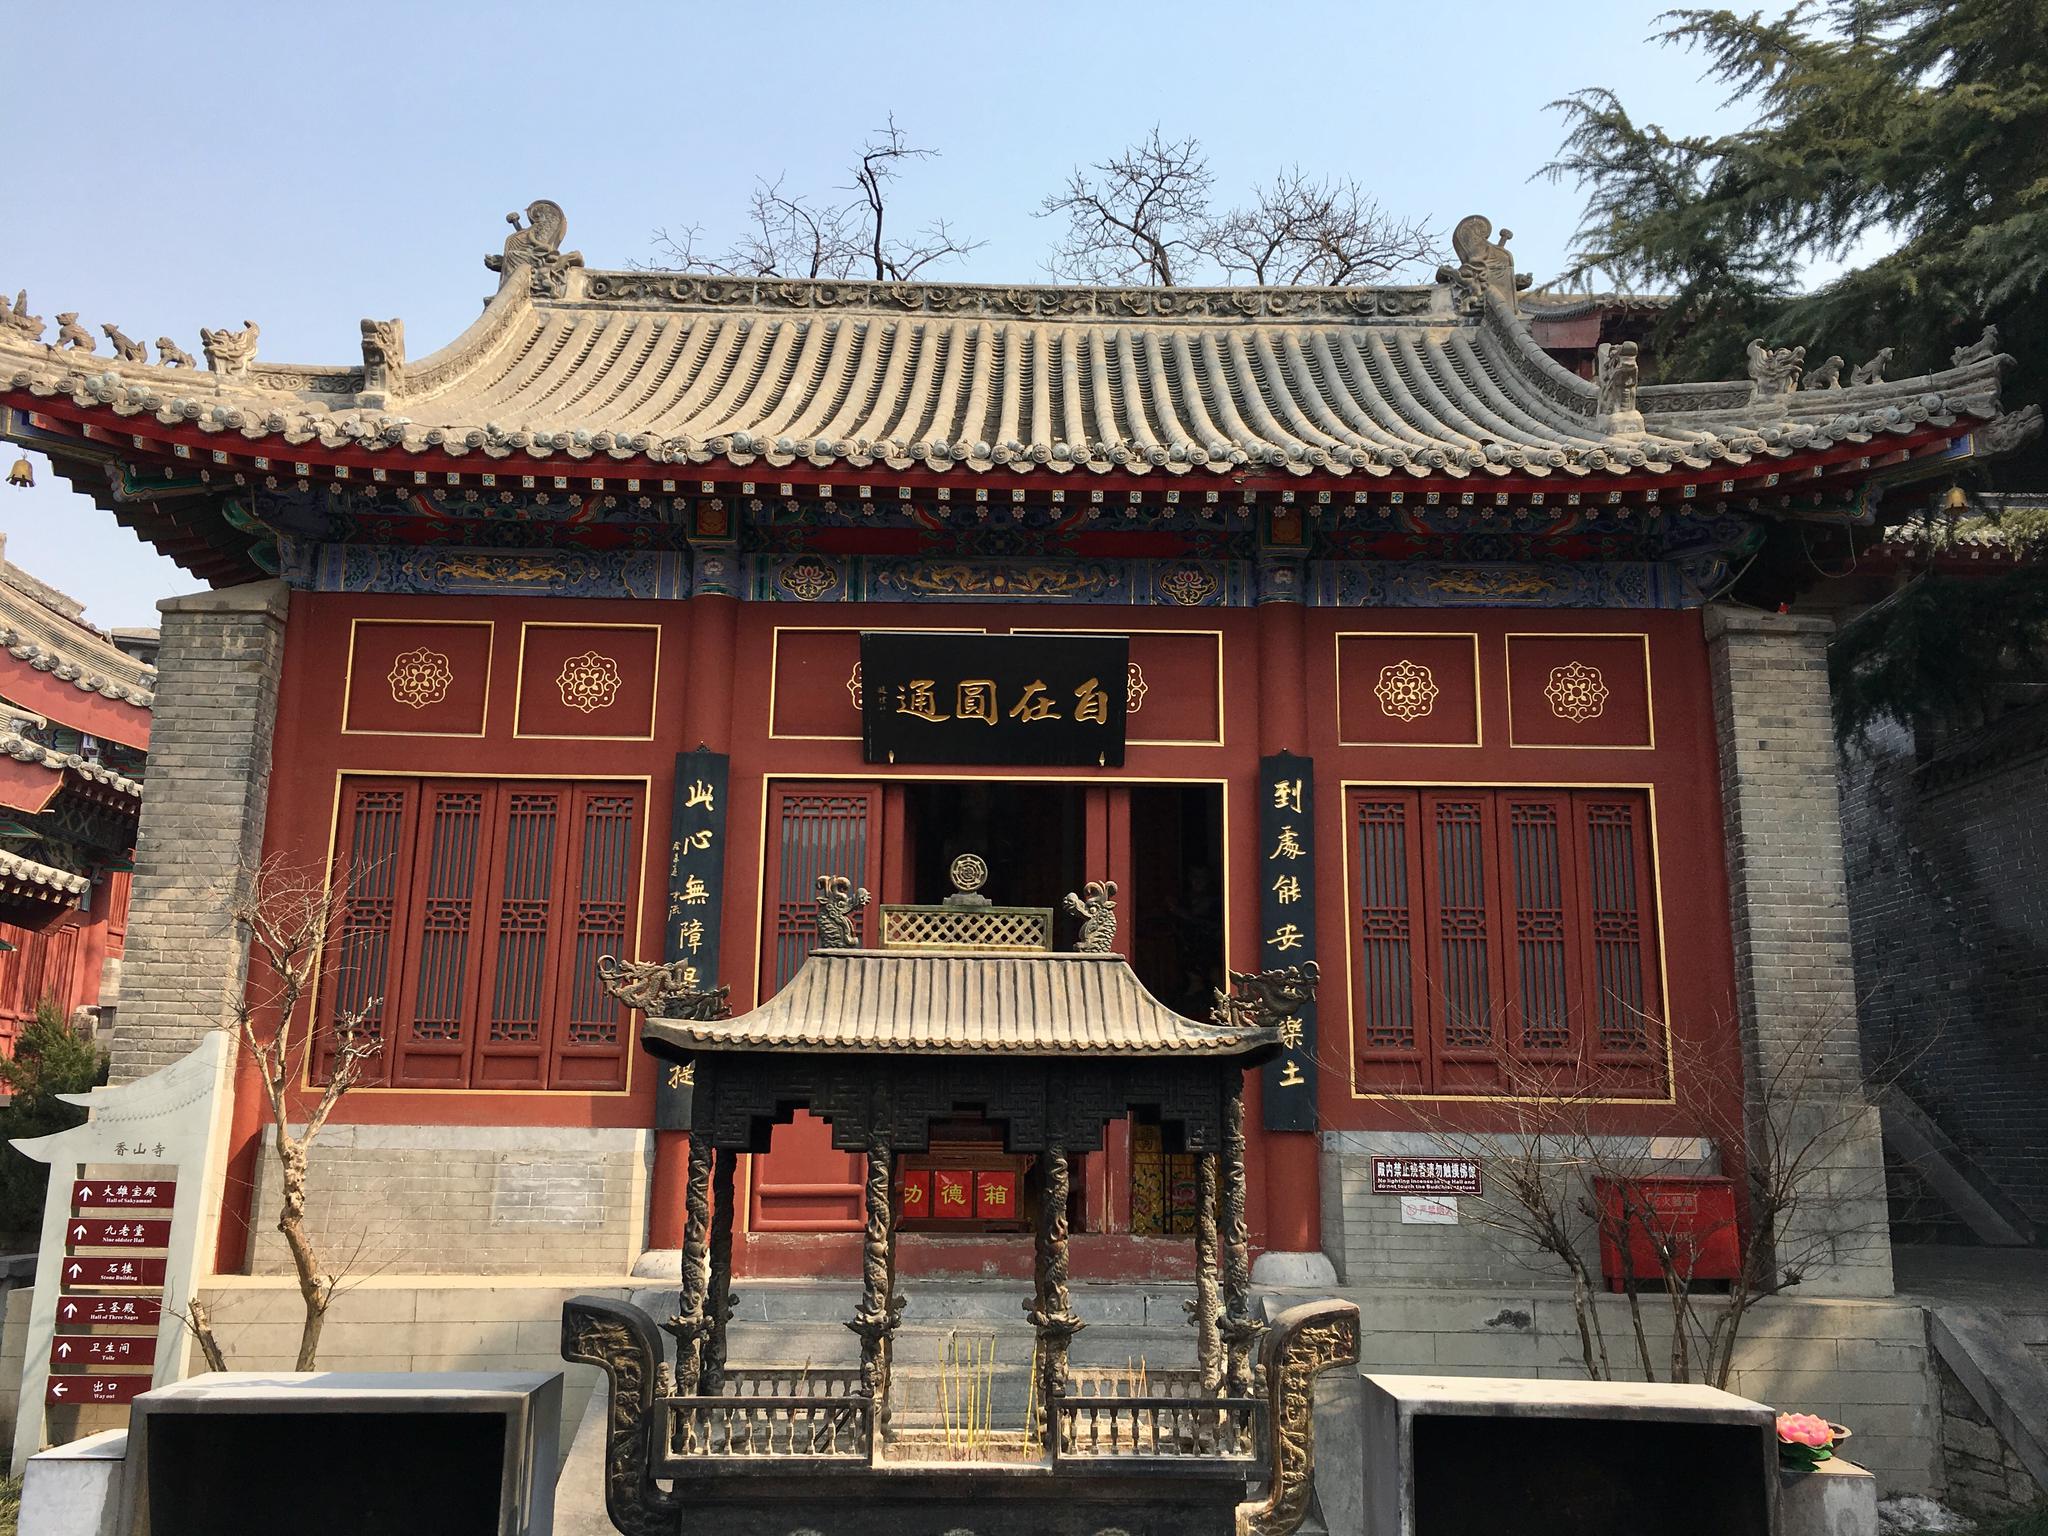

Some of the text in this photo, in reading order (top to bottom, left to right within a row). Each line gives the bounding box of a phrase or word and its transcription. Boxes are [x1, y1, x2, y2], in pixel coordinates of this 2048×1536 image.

[896, 677, 1109, 726] 自在圓通
[667, 779, 715, 1089] 此心無障是提
[1267, 777, 1306, 1087] 到處能安樂土
[114, 1141, 166, 1158] 香山寺
[102, 1185, 157, 1198] 大雄宝殿
[904, 1183, 1009, 1205] 功德箱
[104, 1224, 145, 1237] 九老堂
[94, 1302, 136, 1314] 三圣殿
[89, 1342, 130, 1354] 卫生间
[93, 1381, 118, 1393] 出口
